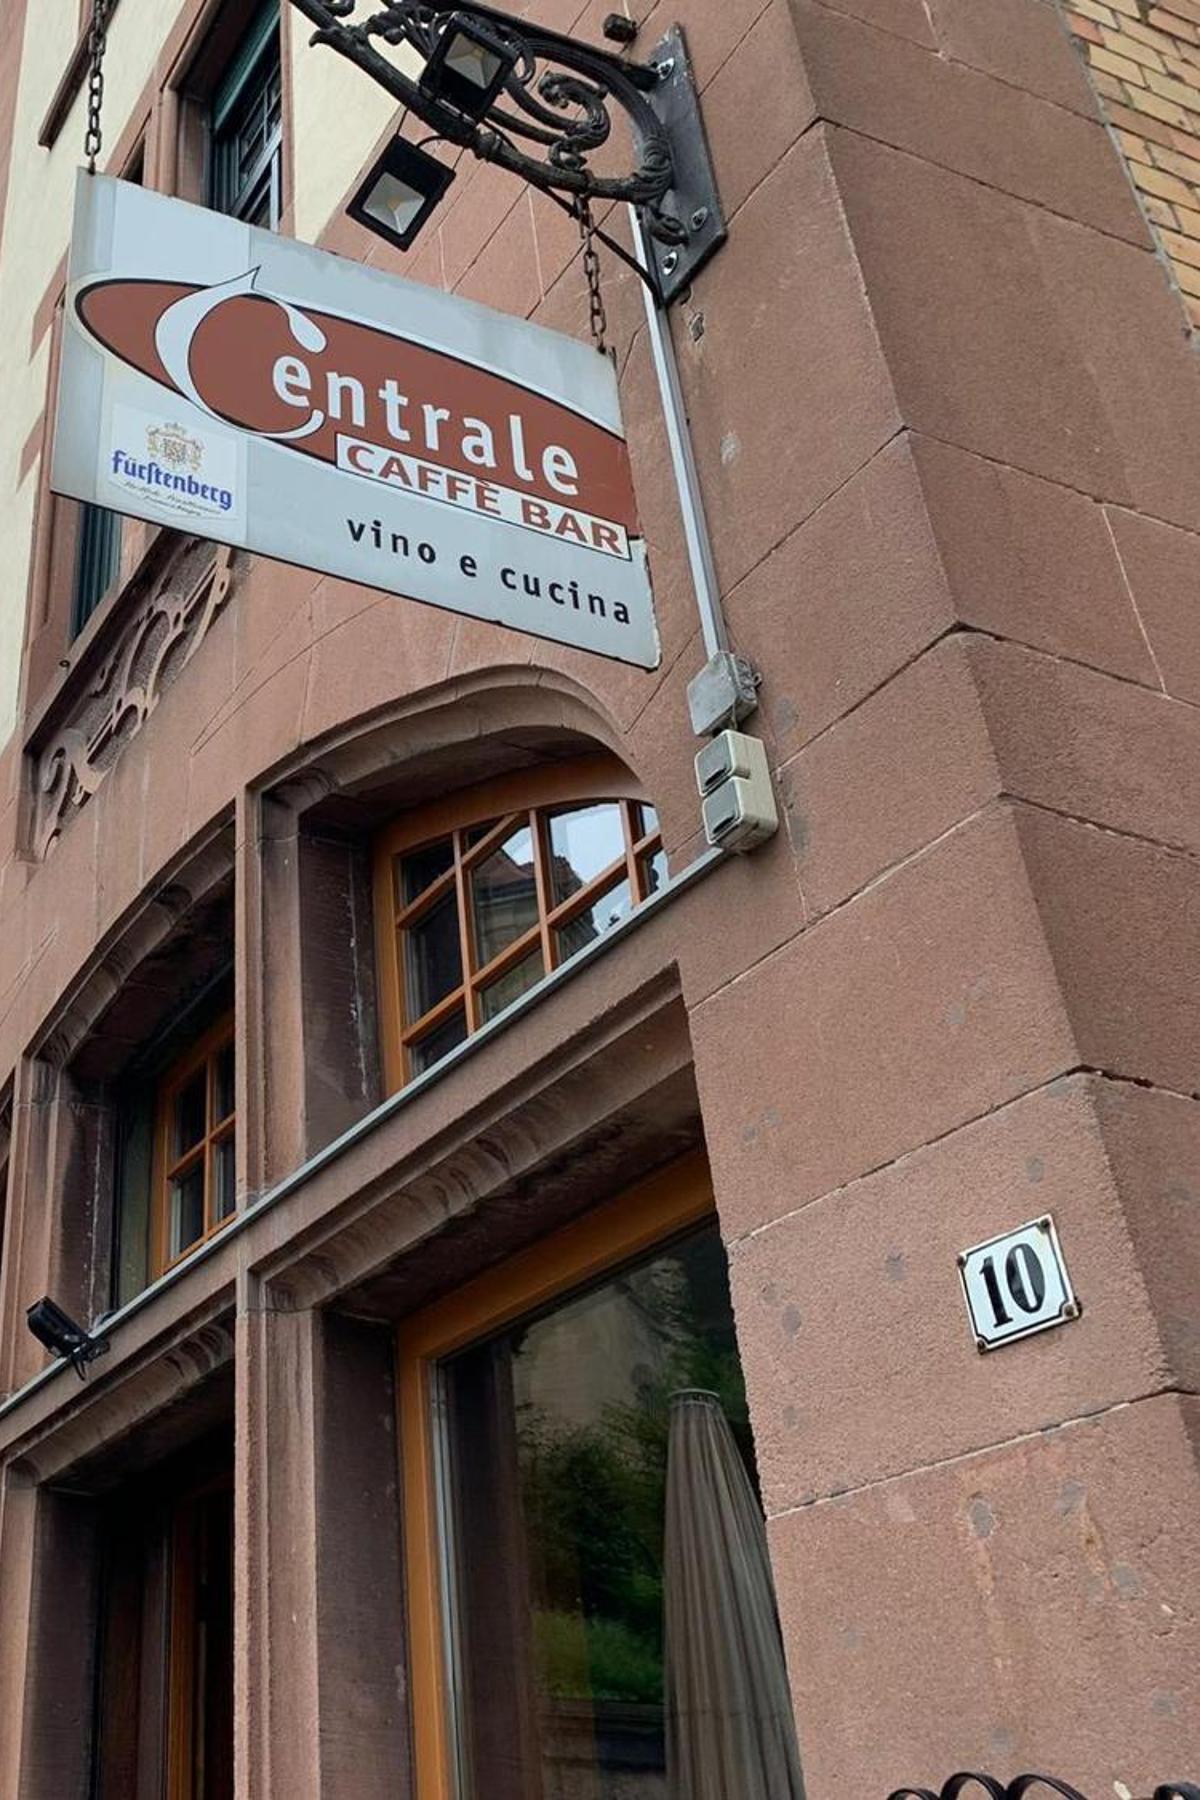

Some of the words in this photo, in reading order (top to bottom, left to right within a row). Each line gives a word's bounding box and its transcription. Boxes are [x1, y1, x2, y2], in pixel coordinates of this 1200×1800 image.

[154, 265, 579, 496] Centrale
[347, 444, 502, 515] CAFFÈ
[521, 499, 623, 554] BAR
[347, 518, 437, 564] vino
[460, 554, 478, 577] e
[500, 567, 631, 625] cucina
[979, 1243, 1046, 1328] 10
